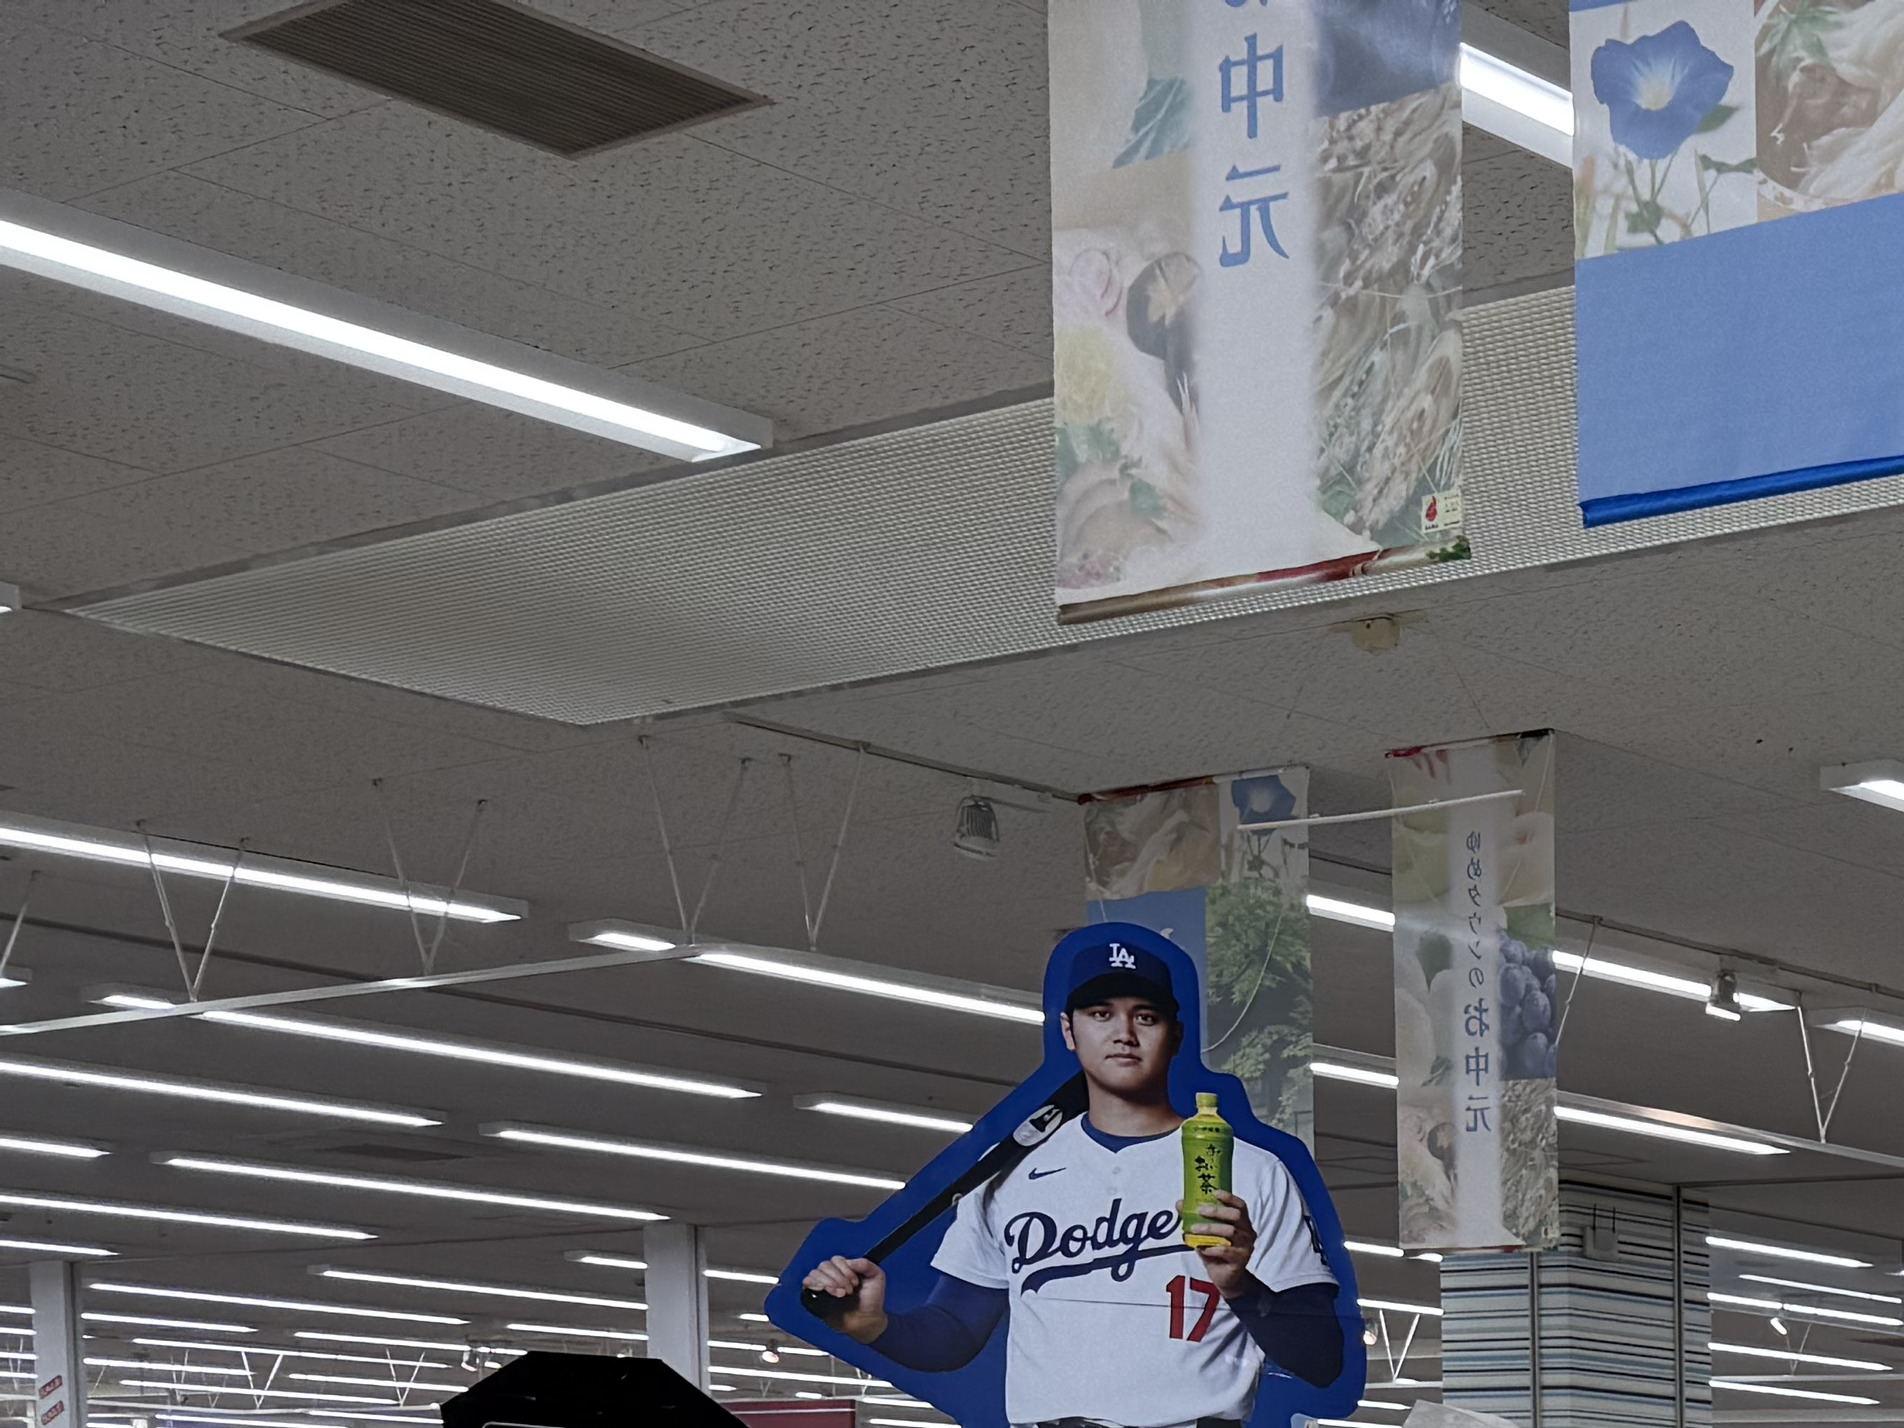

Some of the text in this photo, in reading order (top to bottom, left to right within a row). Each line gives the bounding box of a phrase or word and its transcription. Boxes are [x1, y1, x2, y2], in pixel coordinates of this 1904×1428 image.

[1109, 943, 1136, 969] LA
[1004, 1198, 1182, 1281] Dodge
[1166, 1275, 1221, 1342] 17
